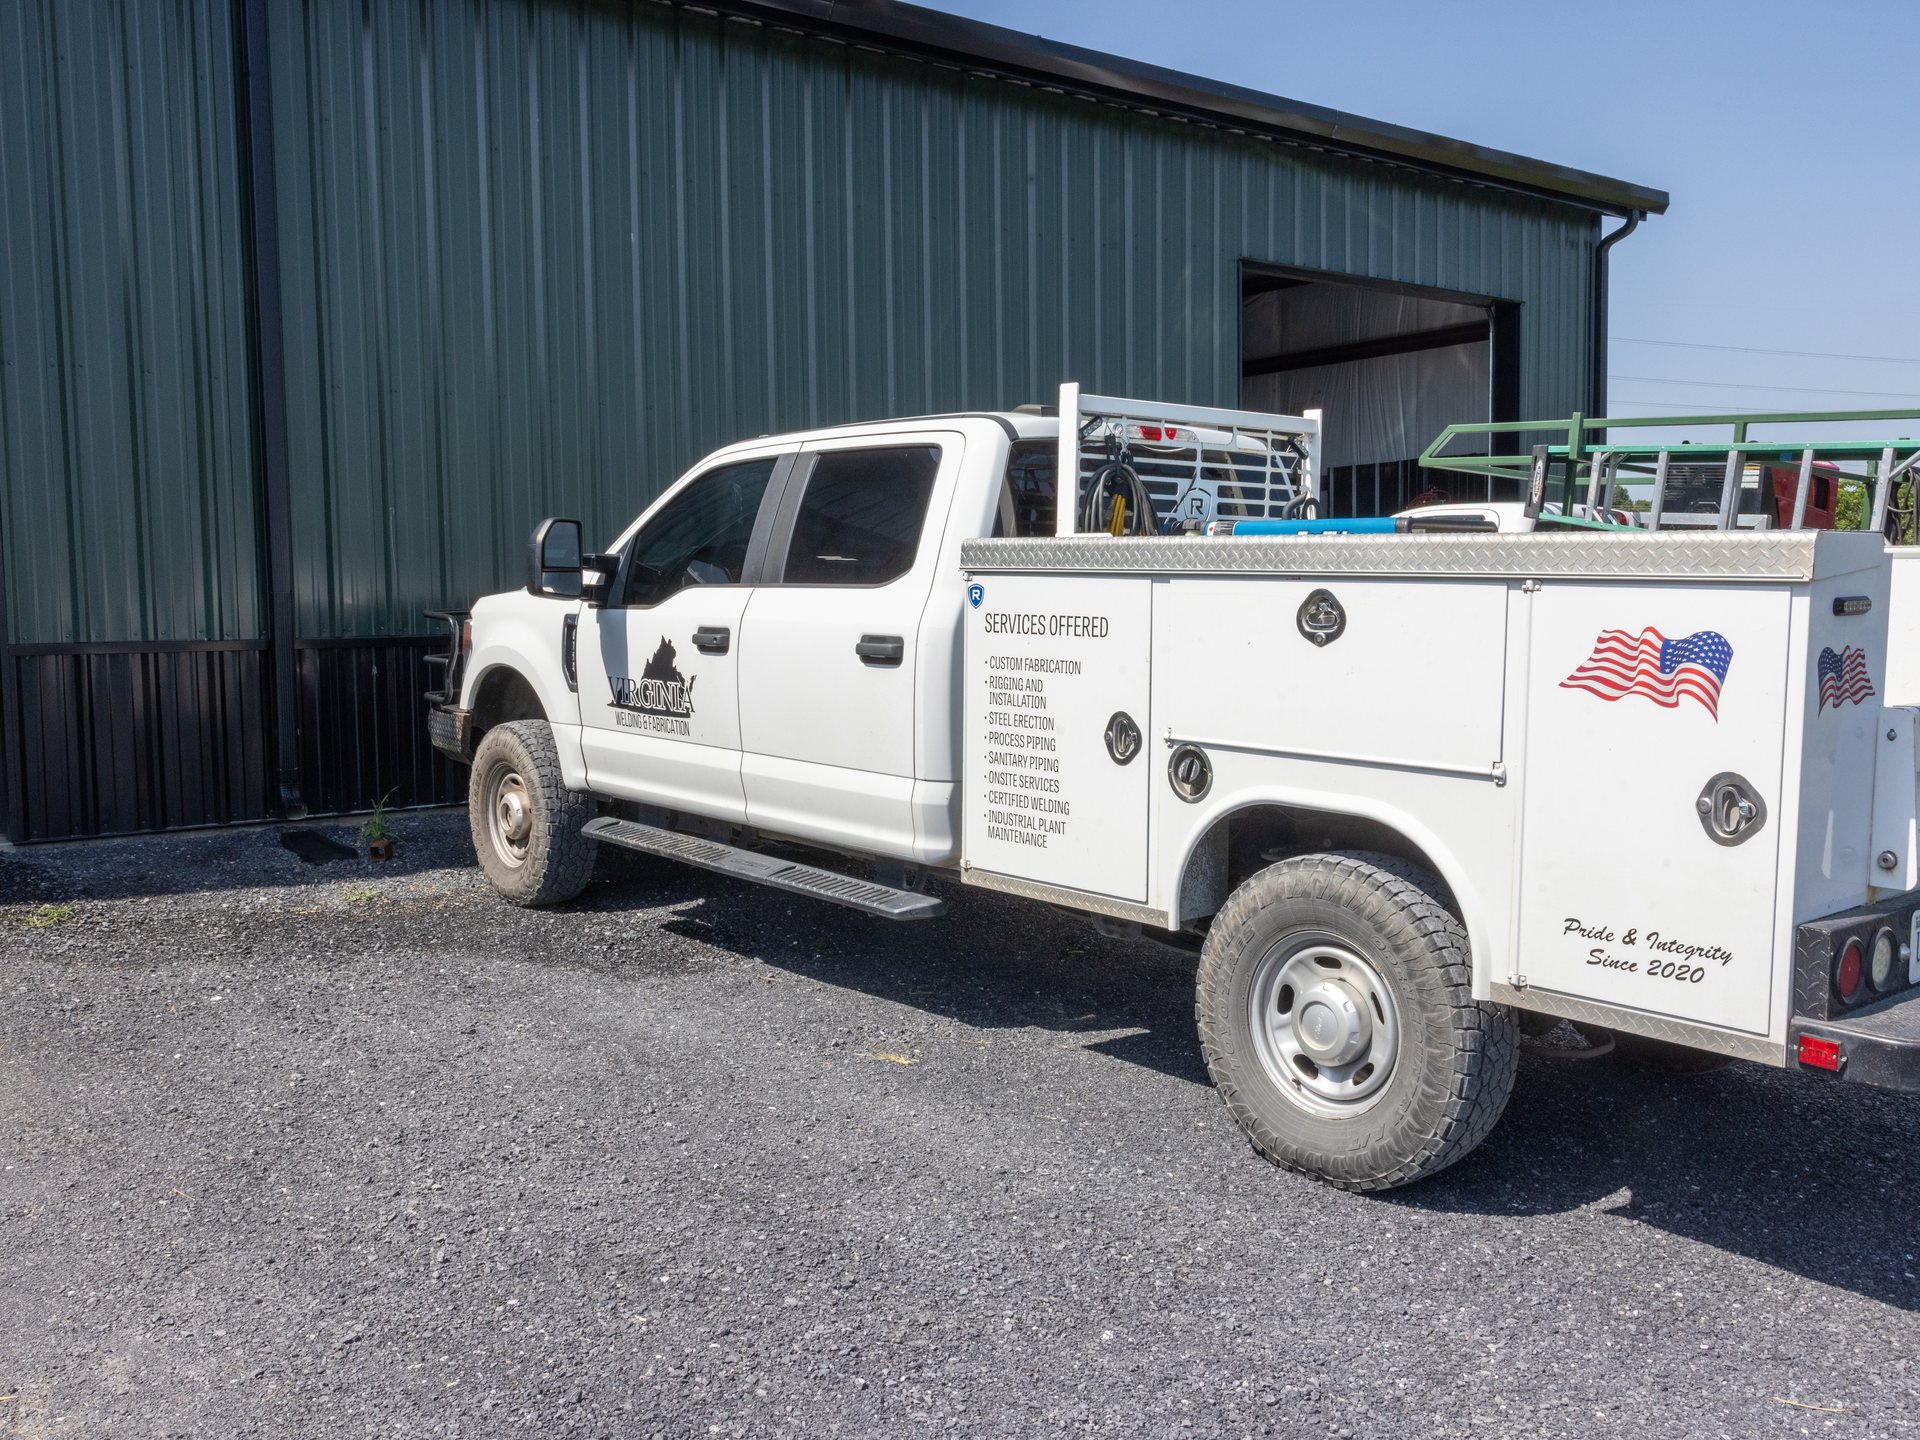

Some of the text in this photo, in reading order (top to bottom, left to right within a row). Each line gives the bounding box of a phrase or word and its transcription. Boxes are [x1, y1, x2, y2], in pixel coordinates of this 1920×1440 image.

[1191, 498, 1203, 515] R
[972, 589, 981, 601] R
[985, 613, 1108, 638] SERVICES OFFERED
[990, 656, 1081, 675] CUSTOM FABRICATION
[608, 675, 697, 713] VIRGINIA
[990, 676, 1043, 692] RIGGING AND
[989, 692, 1046, 709] INSTALLATION
[615, 711, 690, 736] WELDING & FABRICATION
[989, 711, 1054, 731] STEEL ERECTION
[989, 731, 1055, 751] PROCESS PIPING
[989, 751, 1059, 772] SANITARY PIPING
[989, 770, 1059, 793] ONSITE SERVICES
[989, 790, 1069, 815] CERTIFIED WELDING
[989, 810, 1066, 835] INDUSTRIAL PLANT
[988, 825, 1047, 848] MAINTENANCE
[1563, 918, 1732, 966] Pride & Integrity
[1586, 949, 1705, 983] Since 2020
